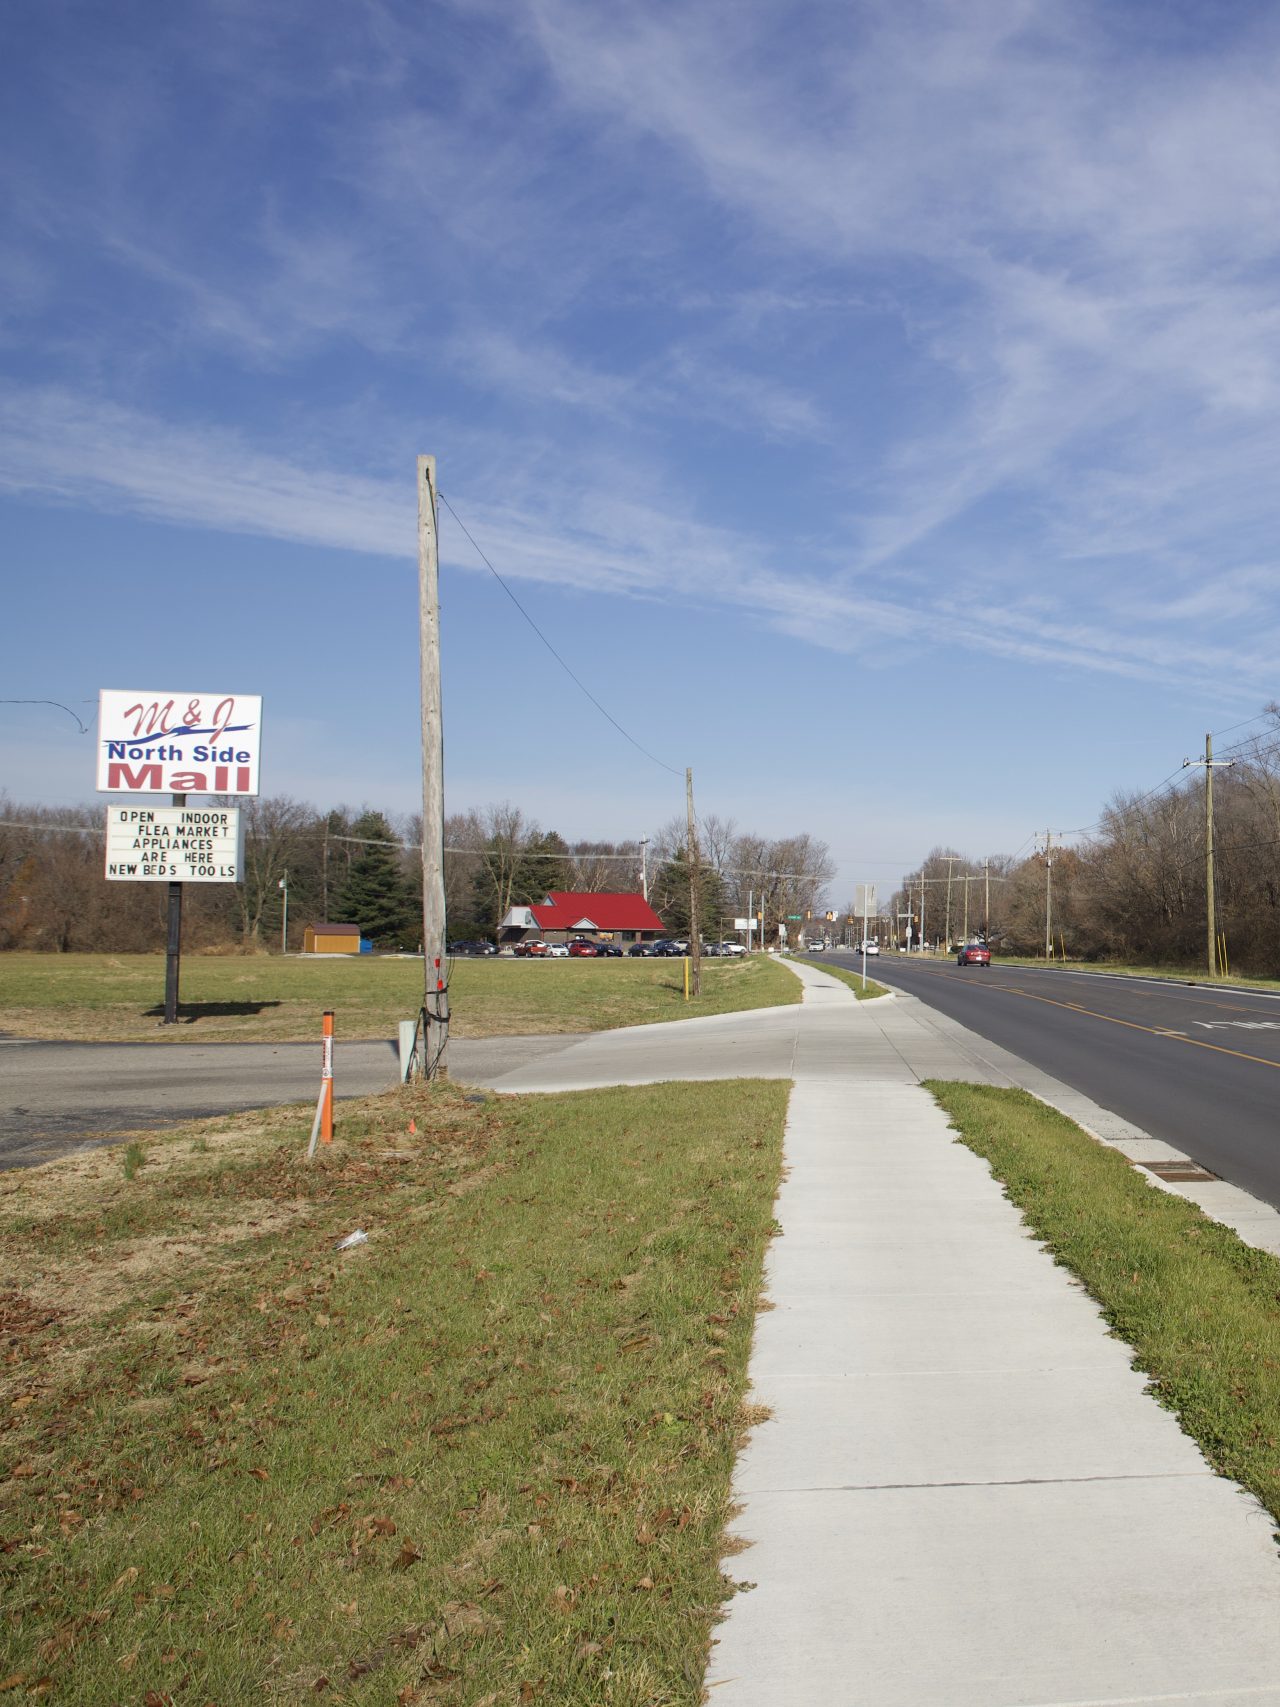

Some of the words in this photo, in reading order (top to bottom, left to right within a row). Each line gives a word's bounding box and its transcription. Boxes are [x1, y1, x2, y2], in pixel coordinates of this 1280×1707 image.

[183, 698, 202, 726] &
[107, 743, 183, 761] North
[192, 745, 251, 763] Side
[107, 763, 250, 792] Mall
[120, 811, 154, 822] OPEN
[181, 813, 228, 824] INDOOR
[138, 825, 170, 836] FLEA
[176, 826, 229, 837] MARKET
[132, 838, 213, 850] APPLIANCES
[141, 852, 167, 862] ARE
[184, 852, 213, 863] HERE
[109, 864, 137, 875] NEW
[143, 864, 177, 875] BEDS
